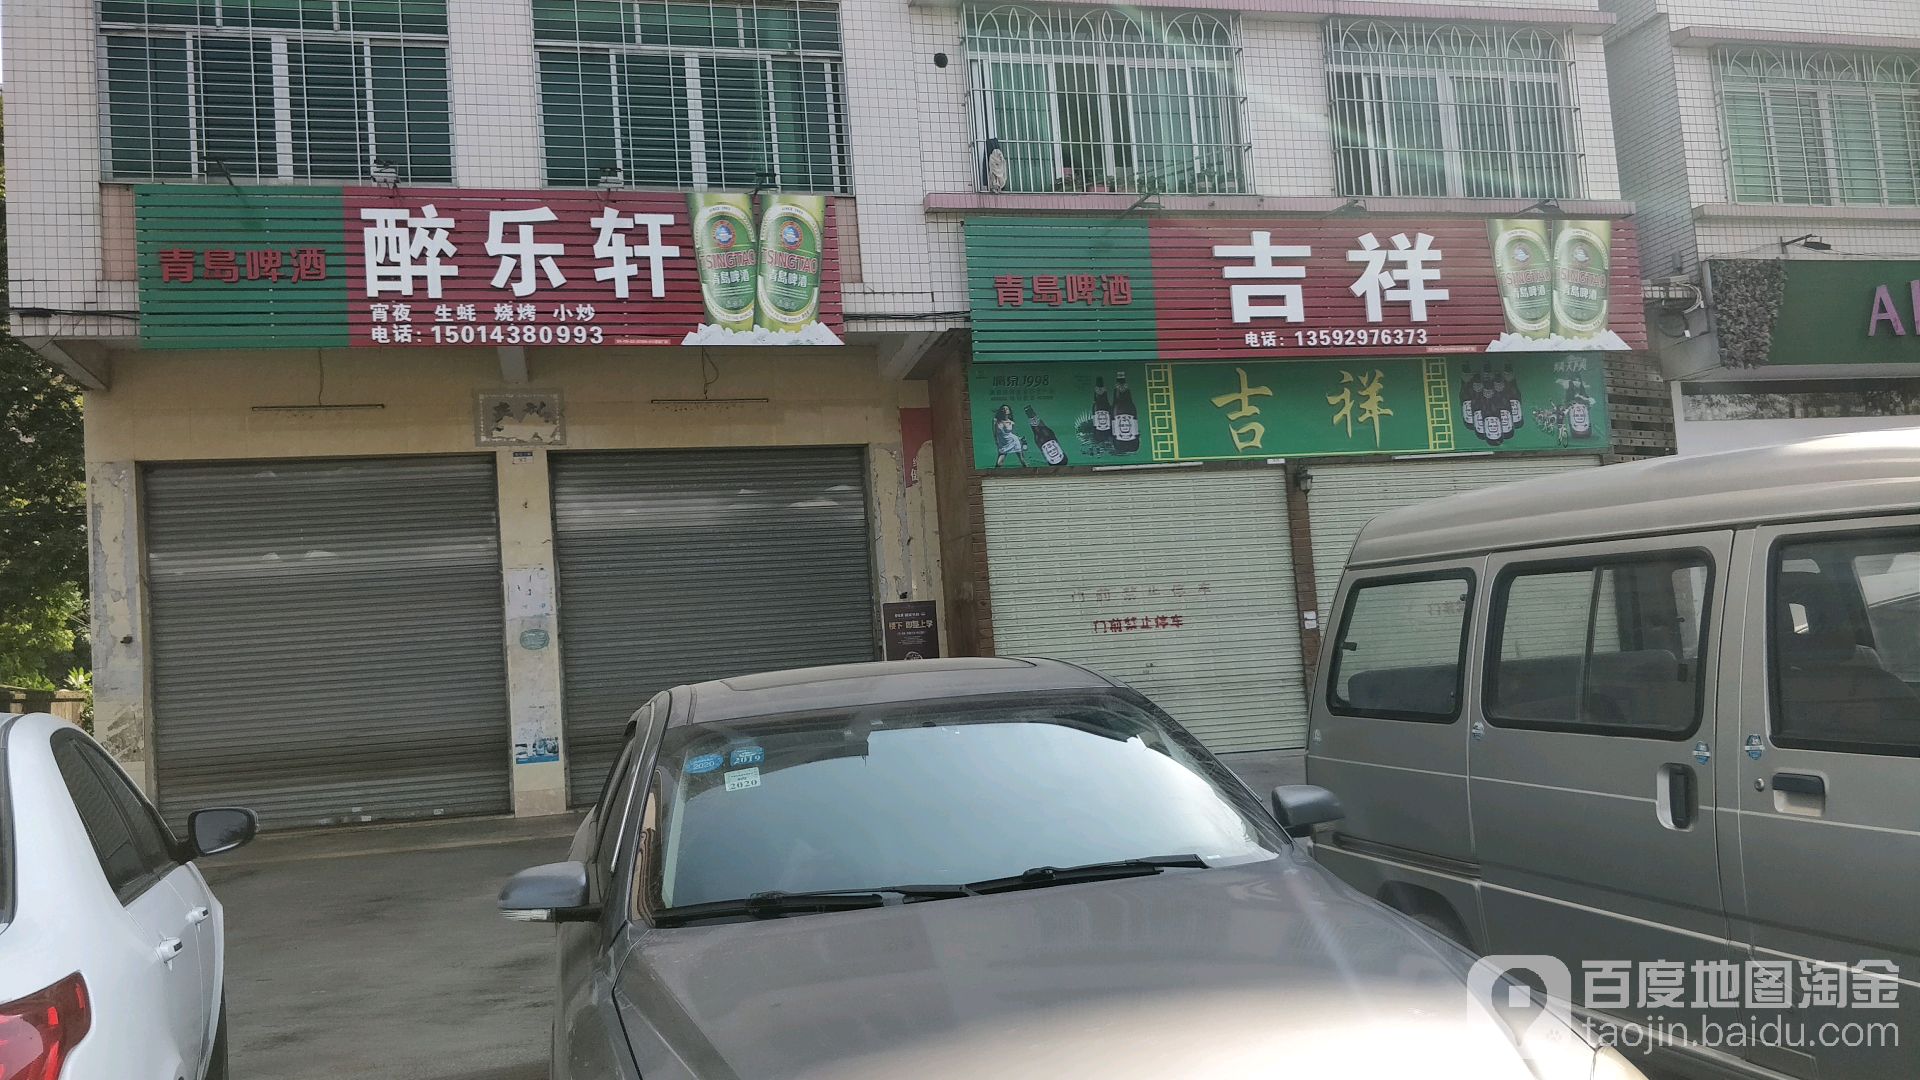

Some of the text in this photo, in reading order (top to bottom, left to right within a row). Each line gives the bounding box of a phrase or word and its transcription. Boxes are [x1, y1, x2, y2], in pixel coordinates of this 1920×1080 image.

[360, 204, 681, 298] 醉乐轩
[1213, 231, 1449, 323] 吉祥
[369, 303, 596, 322] 宵夜 生蚝 烧烤 小炒
[1867, 280, 1920, 337] A
[1210, 367, 1394, 454] 吉祥
[693, 761, 715, 769] 2020
[731, 780, 758, 789] 2020
